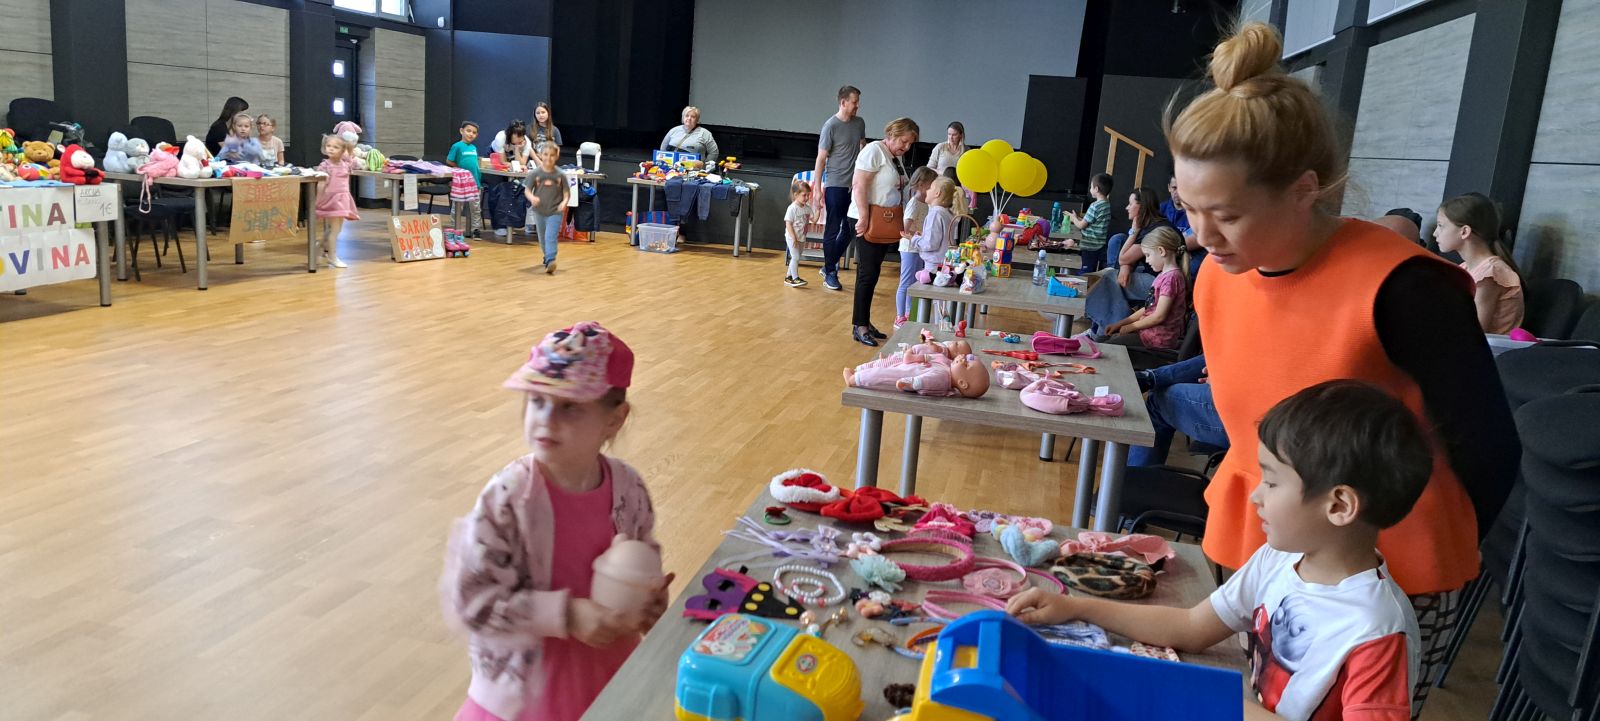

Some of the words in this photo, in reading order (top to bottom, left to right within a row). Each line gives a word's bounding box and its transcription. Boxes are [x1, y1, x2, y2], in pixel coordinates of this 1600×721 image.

[0, 202, 67, 229] INA
[99, 202, 113, 217] 1€
[0, 243, 91, 277] VINA
